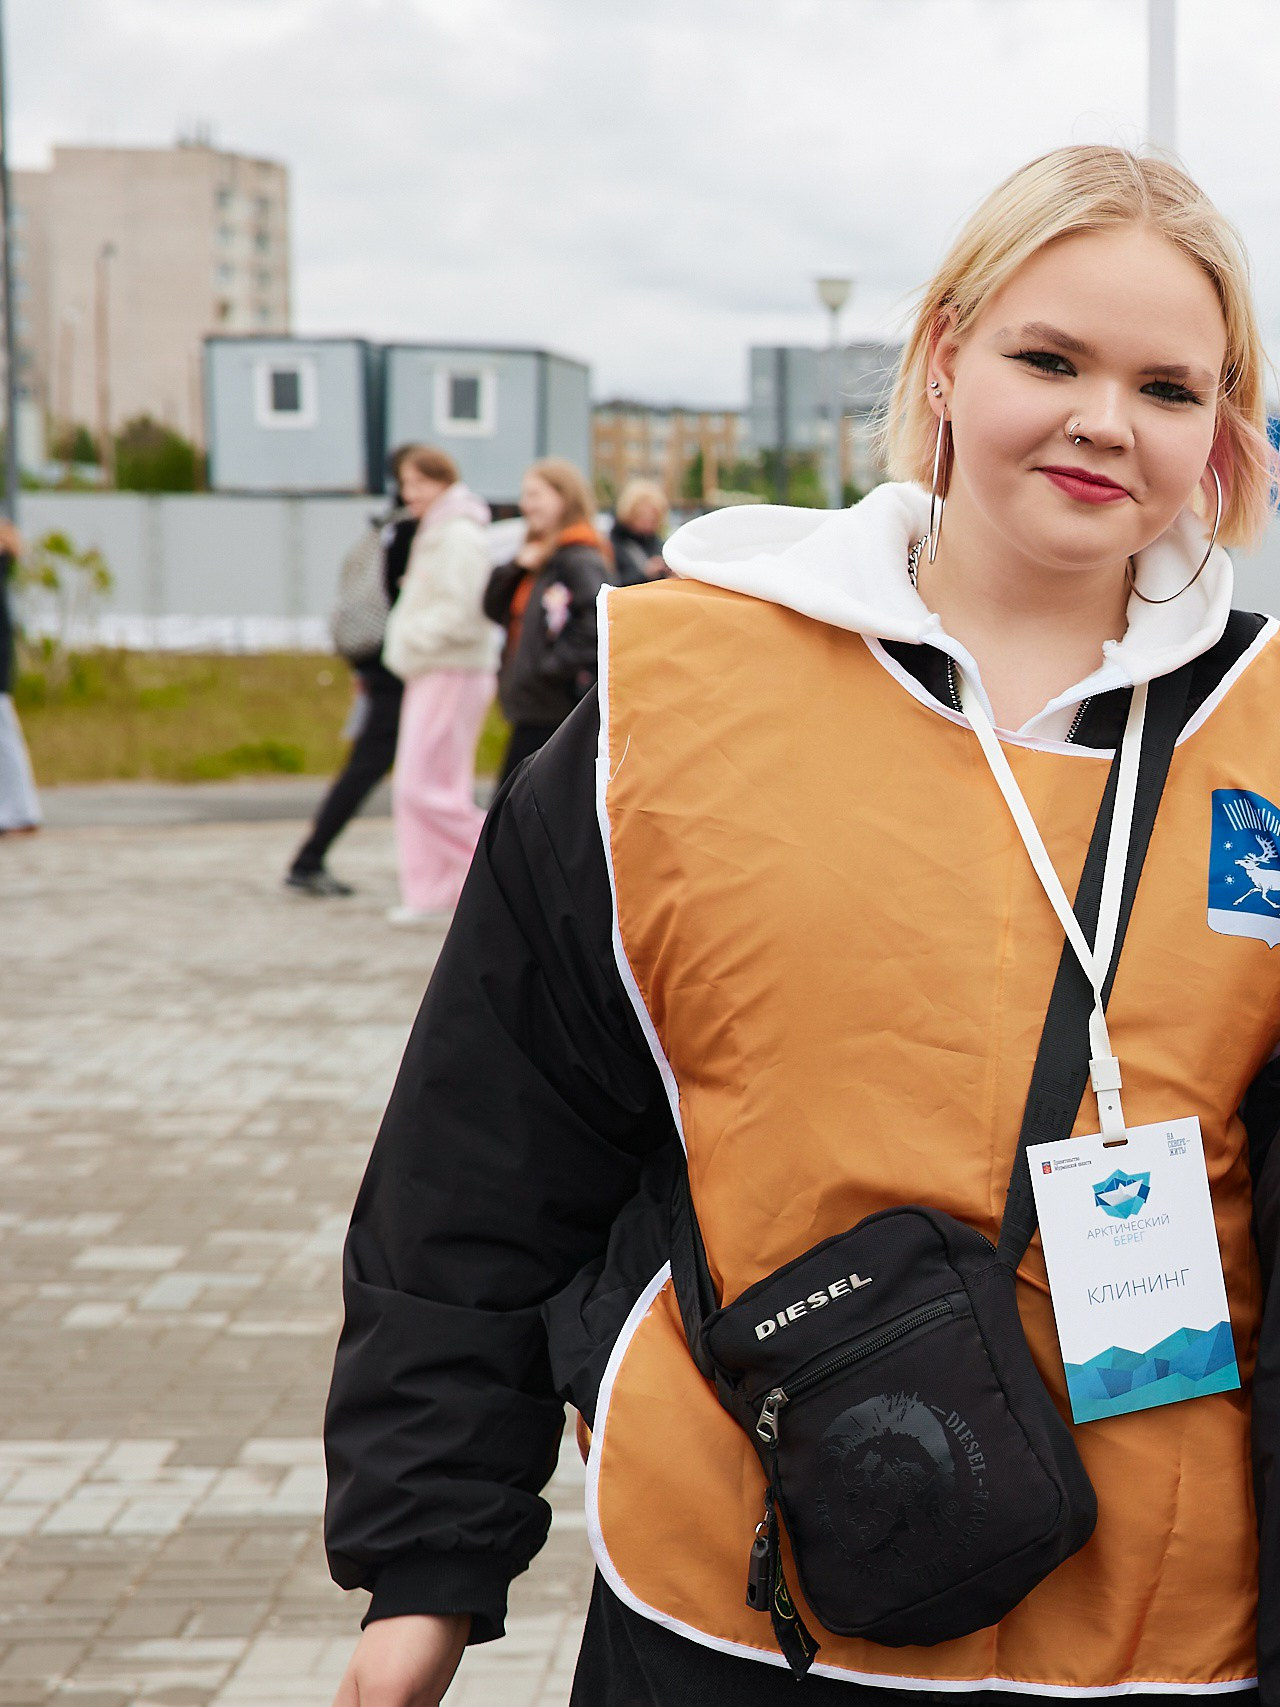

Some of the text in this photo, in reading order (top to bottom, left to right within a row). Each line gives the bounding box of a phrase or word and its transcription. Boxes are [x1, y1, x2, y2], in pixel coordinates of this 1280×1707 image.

[1087, 1213, 1170, 1240] АРКТИЧЕСКИЙ
[1113, 1231, 1146, 1247] БЕРЕГ
[1087, 1268, 1190, 1306] КЛИНИНГ
[755, 1272, 873, 1342] DIESEL
[946, 1411, 987, 1475] DIESEL
